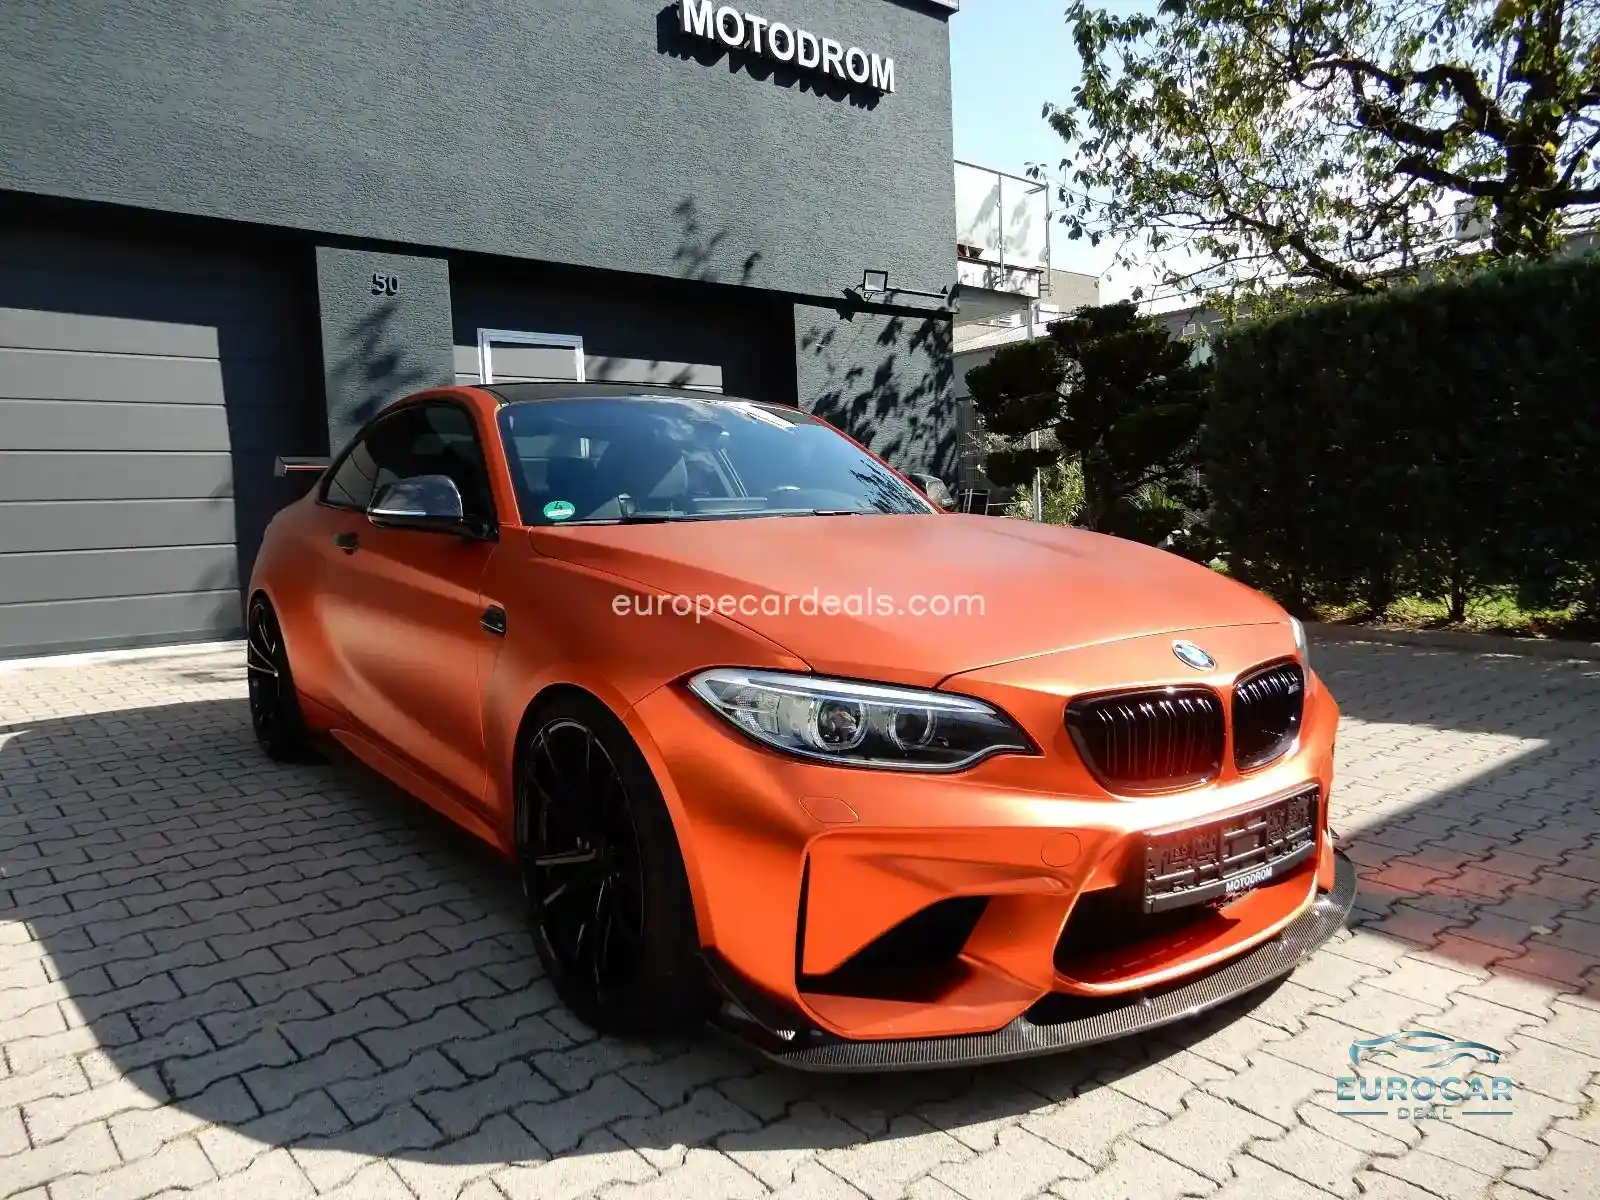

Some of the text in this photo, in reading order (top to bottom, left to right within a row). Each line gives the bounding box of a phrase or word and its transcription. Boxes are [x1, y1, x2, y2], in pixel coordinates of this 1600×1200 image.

[681, 0, 895, 93] MOTODROM
[372, 272, 400, 294] 50
[1225, 866, 1273, 892] MOTODROM
